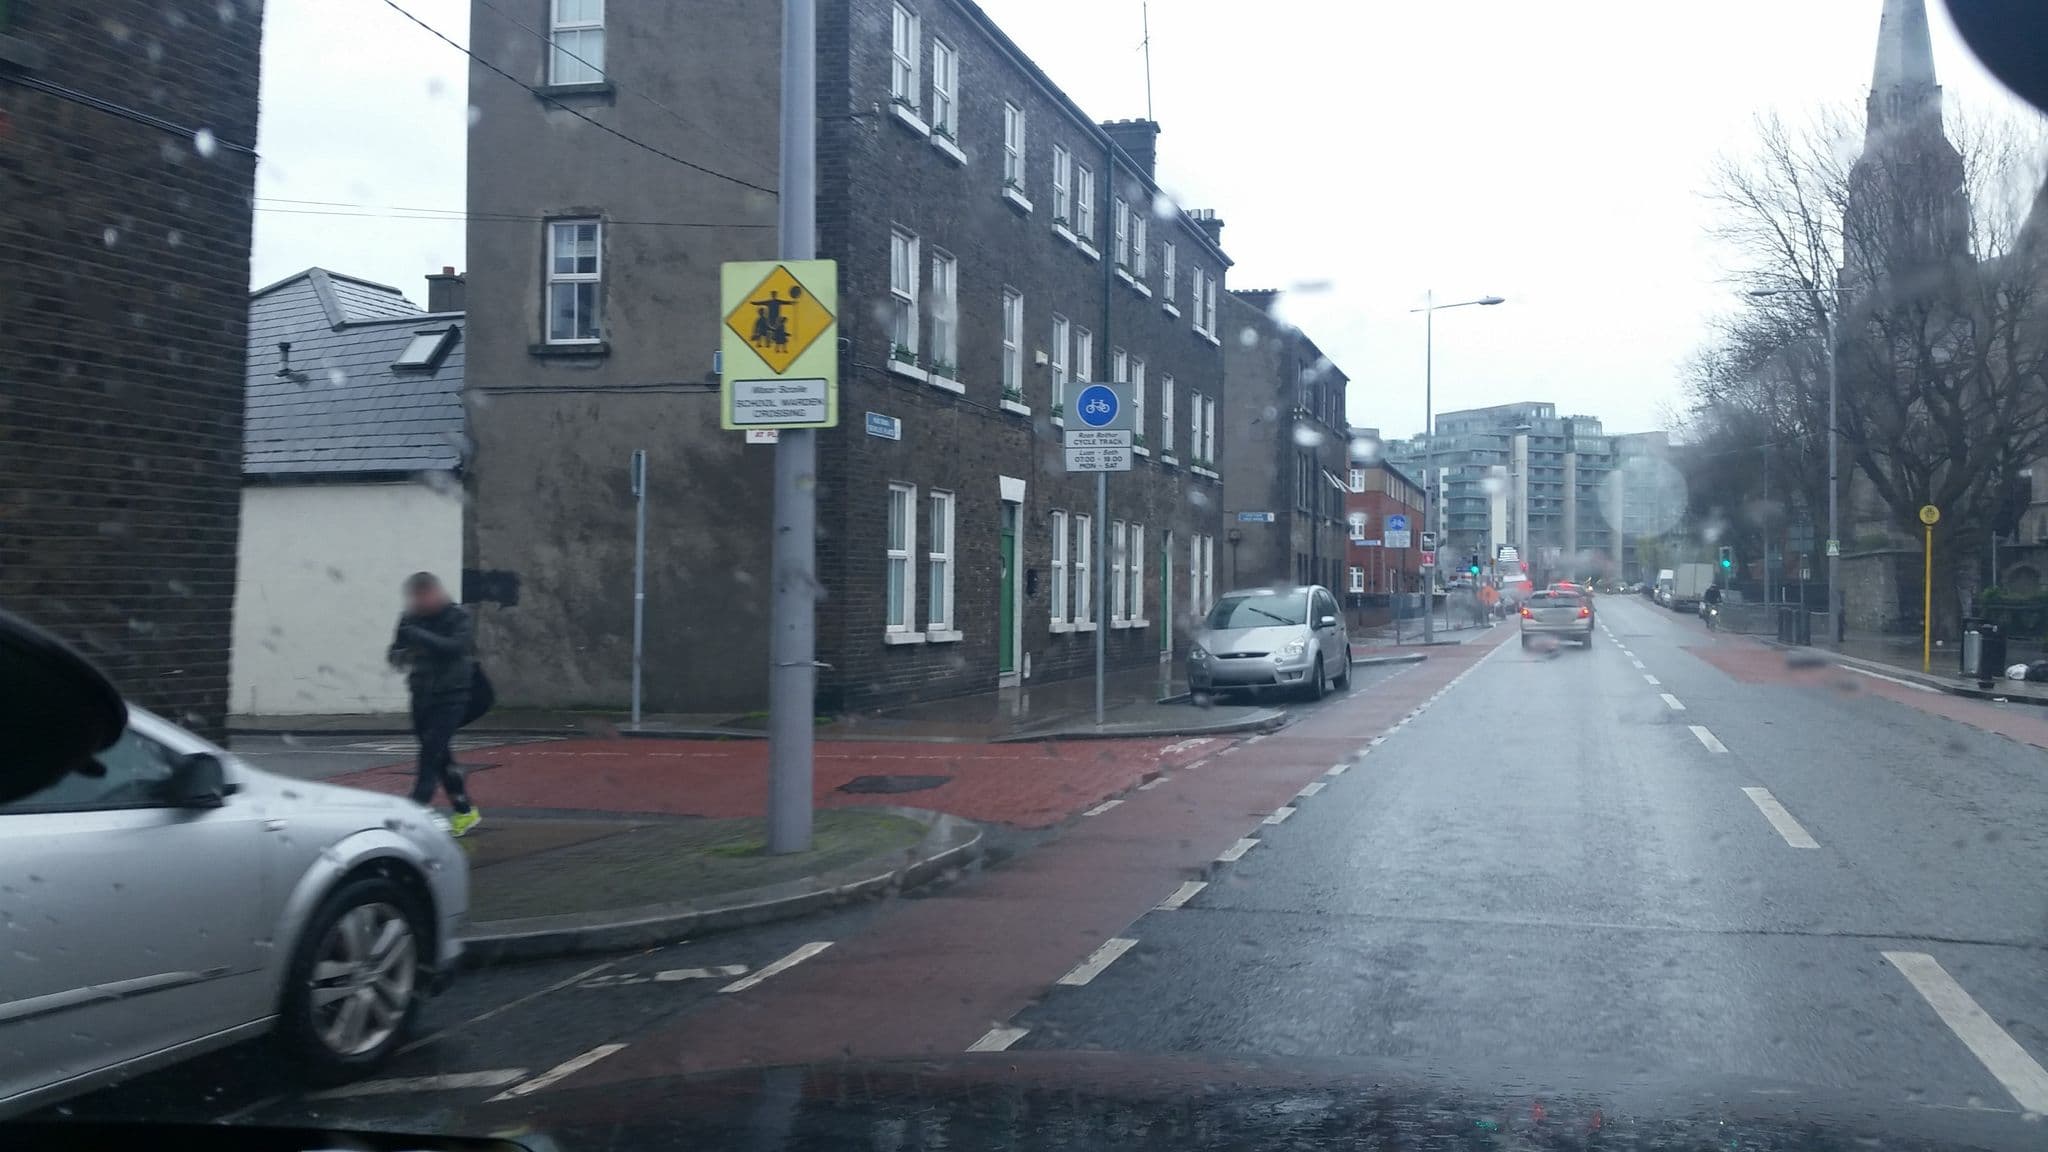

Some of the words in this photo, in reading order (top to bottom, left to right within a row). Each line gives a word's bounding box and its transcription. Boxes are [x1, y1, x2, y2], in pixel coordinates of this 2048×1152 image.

[735, 399, 778, 408] SCHOOL
[781, 397, 825, 406] WARDEN
[752, 408, 807, 418] CROSSING
[1073, 438, 1097, 446] CYCLE
